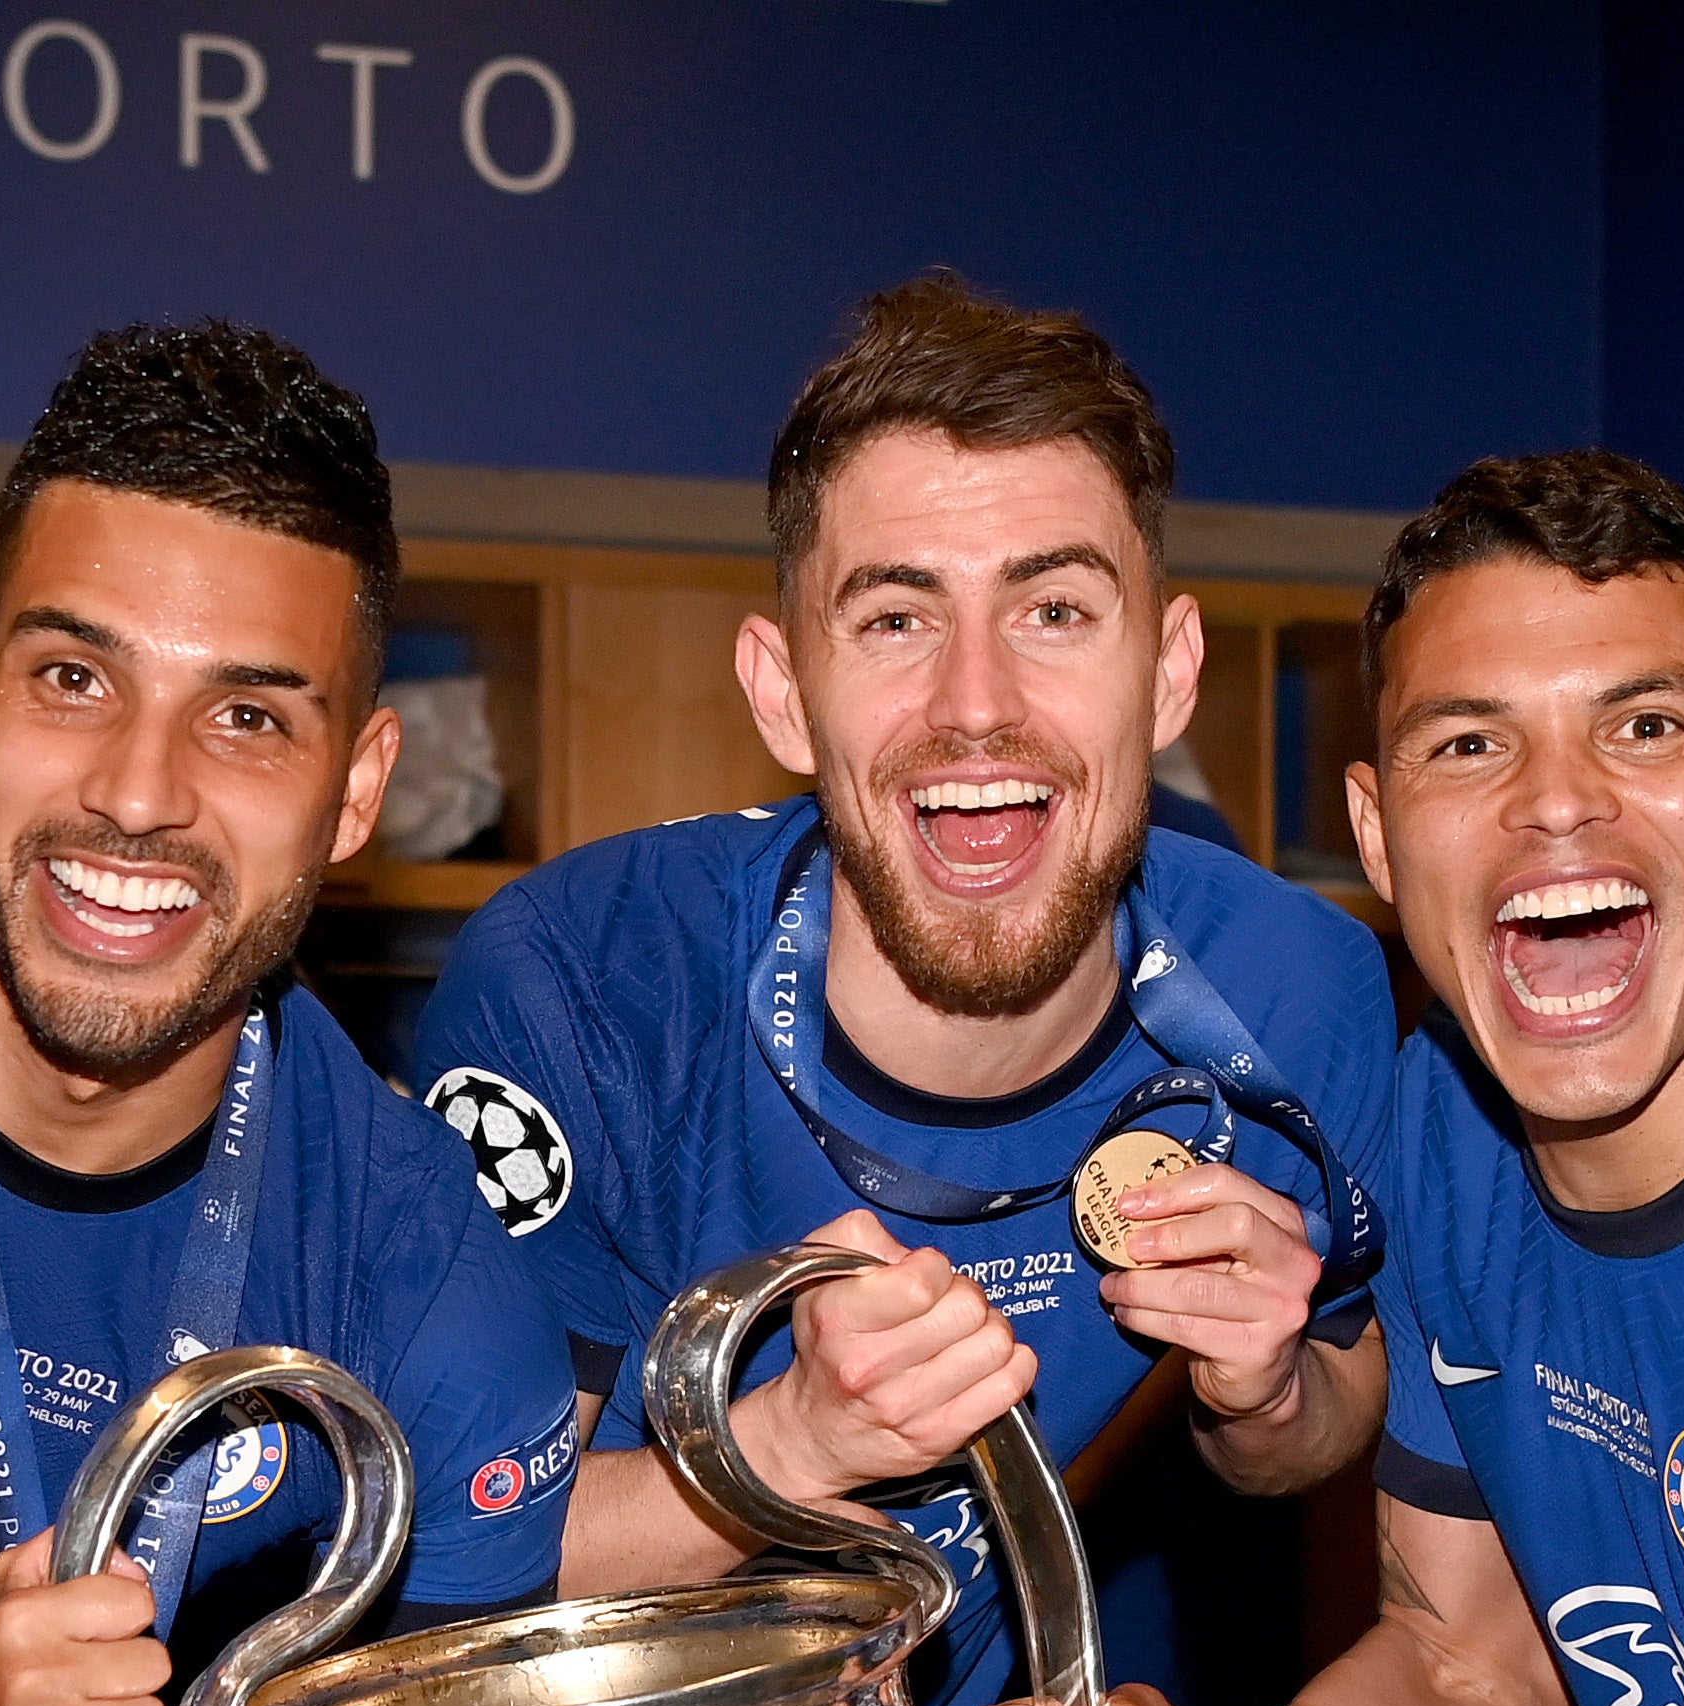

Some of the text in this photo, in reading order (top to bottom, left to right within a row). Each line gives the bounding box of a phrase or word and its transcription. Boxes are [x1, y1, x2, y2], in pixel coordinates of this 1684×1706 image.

[773, 969, 797, 1048] 2021
[225, 1060, 256, 1157] FINAL
[1271, 1101, 1316, 1134] FIN
[1087, 1160, 1133, 1241] CHAMPI
[1086, 1193, 1121, 1251] LEAGUE
[1021, 1252, 1076, 1278] 2021
[1013, 1281, 1027, 1296] 29
[1028, 1278, 1055, 1294] MAY
[1001, 1296, 1061, 1317] CHELSEA FC
[41, 1387, 61, 1405] 29
[61, 1394, 92, 1413] MAY
[57, 1363, 118, 1404] 2021
[1534, 1363, 1585, 1401] FINAL
[75, 1419, 93, 1435] FC
[529, 1408, 577, 1486] RESP
[205, 1500, 241, 1516] CLUB
[133, 1537, 161, 1574] 21
